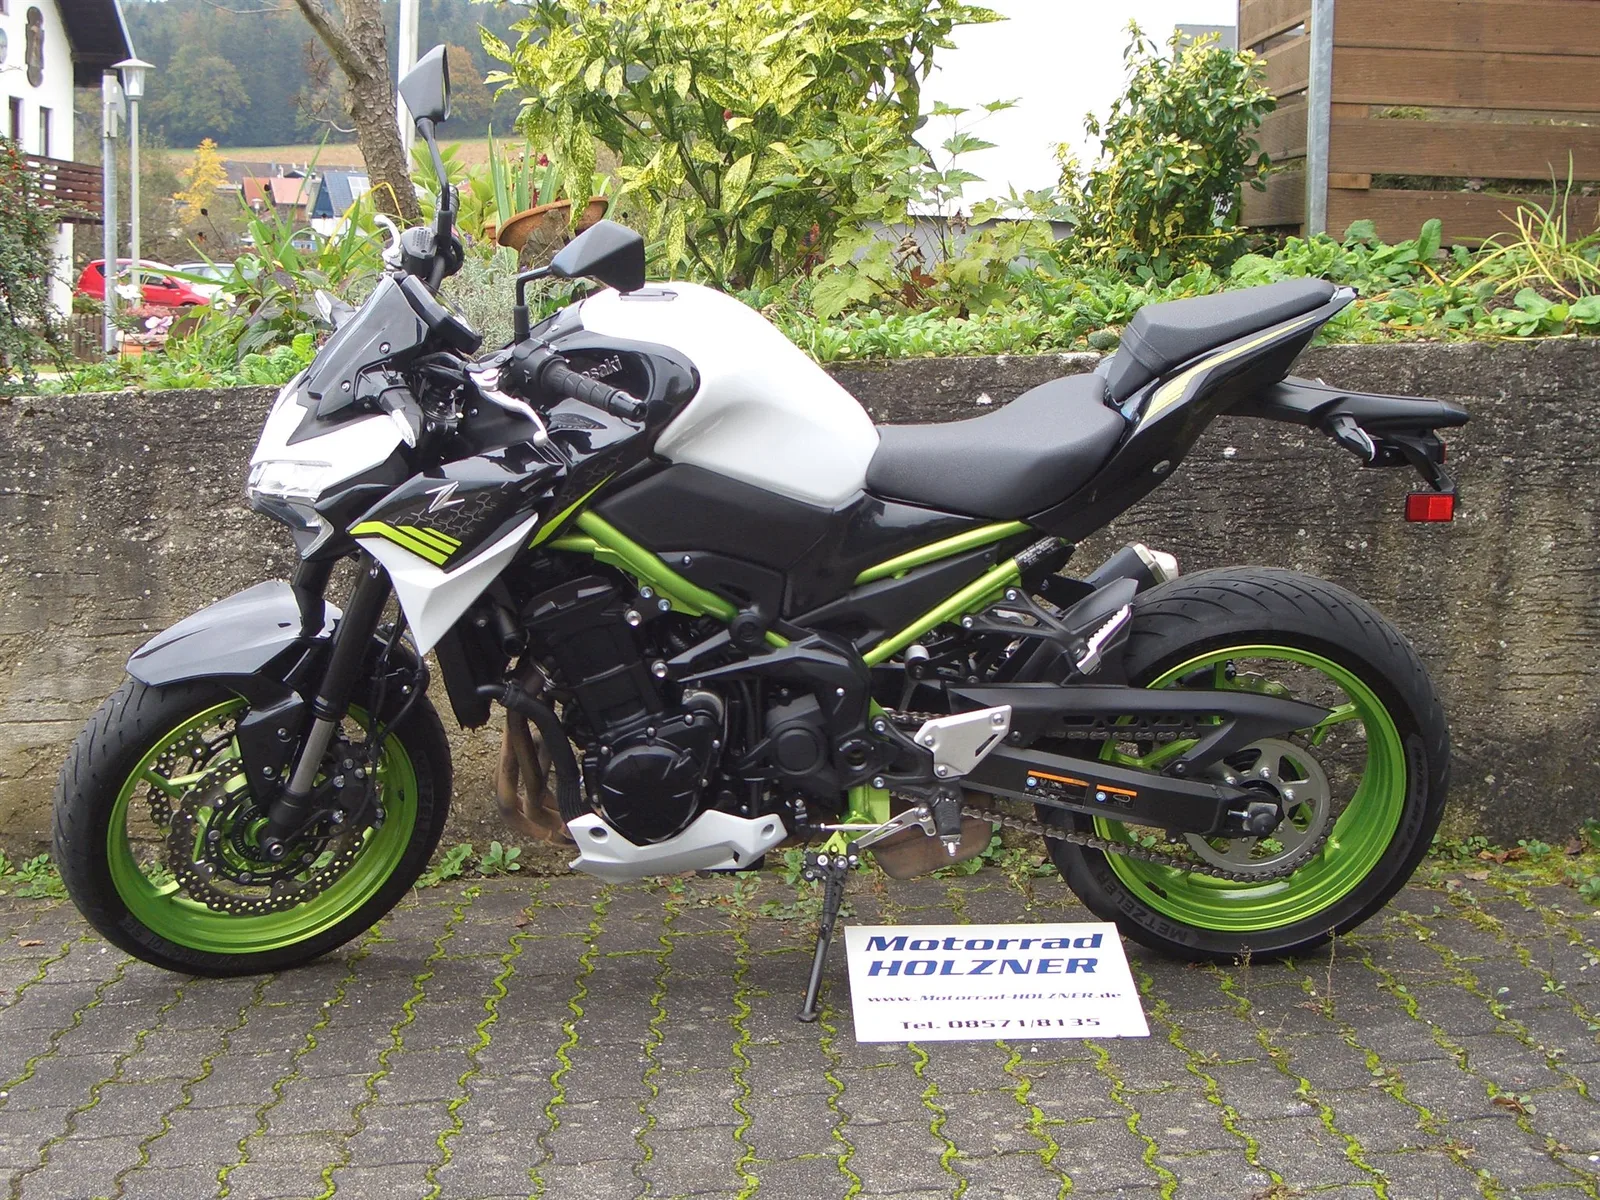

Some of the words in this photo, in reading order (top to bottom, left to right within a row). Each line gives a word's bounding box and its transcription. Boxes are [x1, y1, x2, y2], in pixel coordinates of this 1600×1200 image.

[1096, 870, 1188, 942] METZELER
[866, 933, 1103, 952] Motorrad
[868, 958, 1098, 977] HOLZNER
[868, 992, 1122, 1002] www.Motorrad-HOLZNER.de
[901, 1020, 941, 1031] Tel.
[948, 1017, 1101, 1030] 08571/8135
